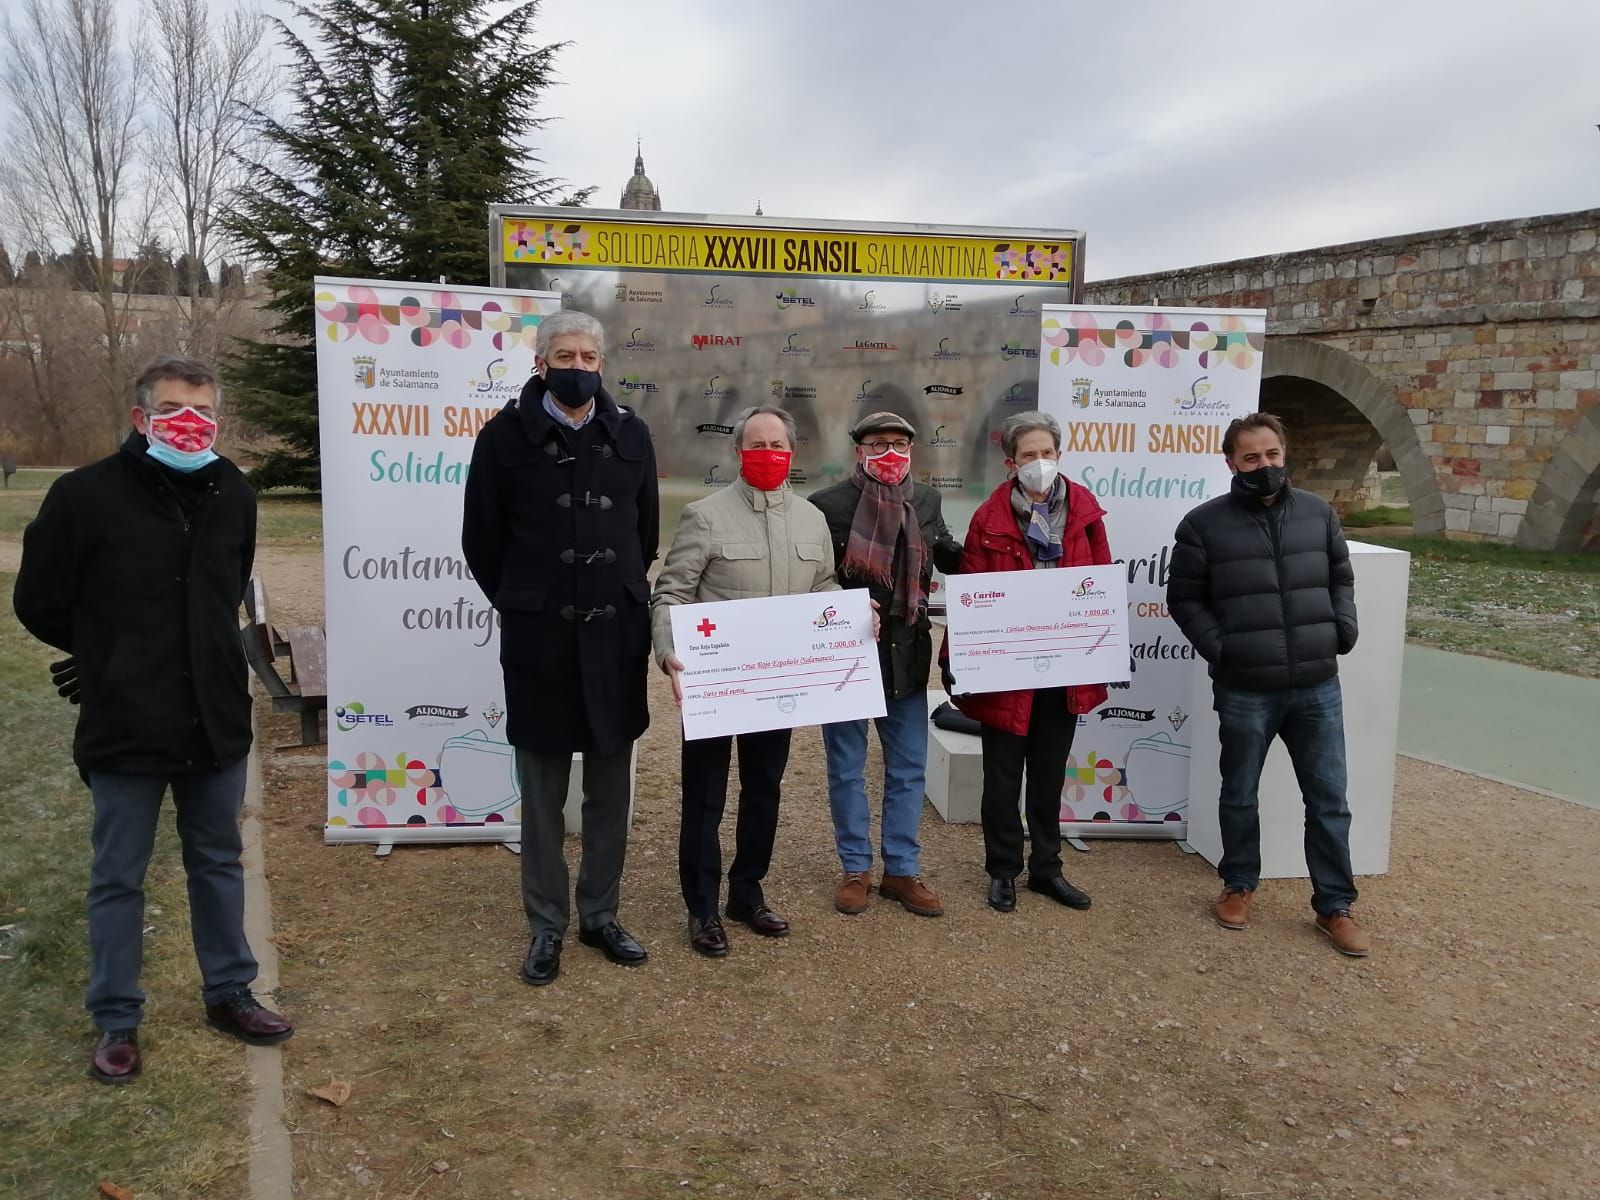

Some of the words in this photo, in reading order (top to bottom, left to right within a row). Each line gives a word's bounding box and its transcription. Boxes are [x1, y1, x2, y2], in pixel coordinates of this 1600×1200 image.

[597, 231, 700, 267] SOLIDARIA
[704, 235, 776, 270] XXXVII
[783, 238, 862, 274] SANSIL
[867, 242, 988, 278] SALMANTINA
[782, 297, 815, 305] SETEL
[1007, 348, 1039, 356] SETEL
[380, 367, 439, 379] Ayuntamiento
[380, 378, 391, 387] de
[392, 379, 439, 390] Salamanca
[626, 382, 657, 391] SETEL
[1094, 388, 1147, 398] Ayuntamiento
[1094, 398, 1103, 407] de
[1105, 398, 1146, 408] Salamanca
[352, 402, 430, 437] XXXVII
[444, 406, 503, 438] SAN
[1067, 421, 1136, 453] XXXVII
[1148, 423, 1224, 455] SANSIL
[829, 640, 857, 649] 7.000,00
[859, 638, 865, 646] €
[741, 663, 756, 671] Cruz
[772, 658, 799, 668] Española
[703, 690, 718, 698] Siete
[718, 689, 728, 697] mil
[416, 707, 459, 717] ALJOMAR
[1107, 709, 1146, 720] ALJOMAR
[346, 714, 393, 723] SETEL
